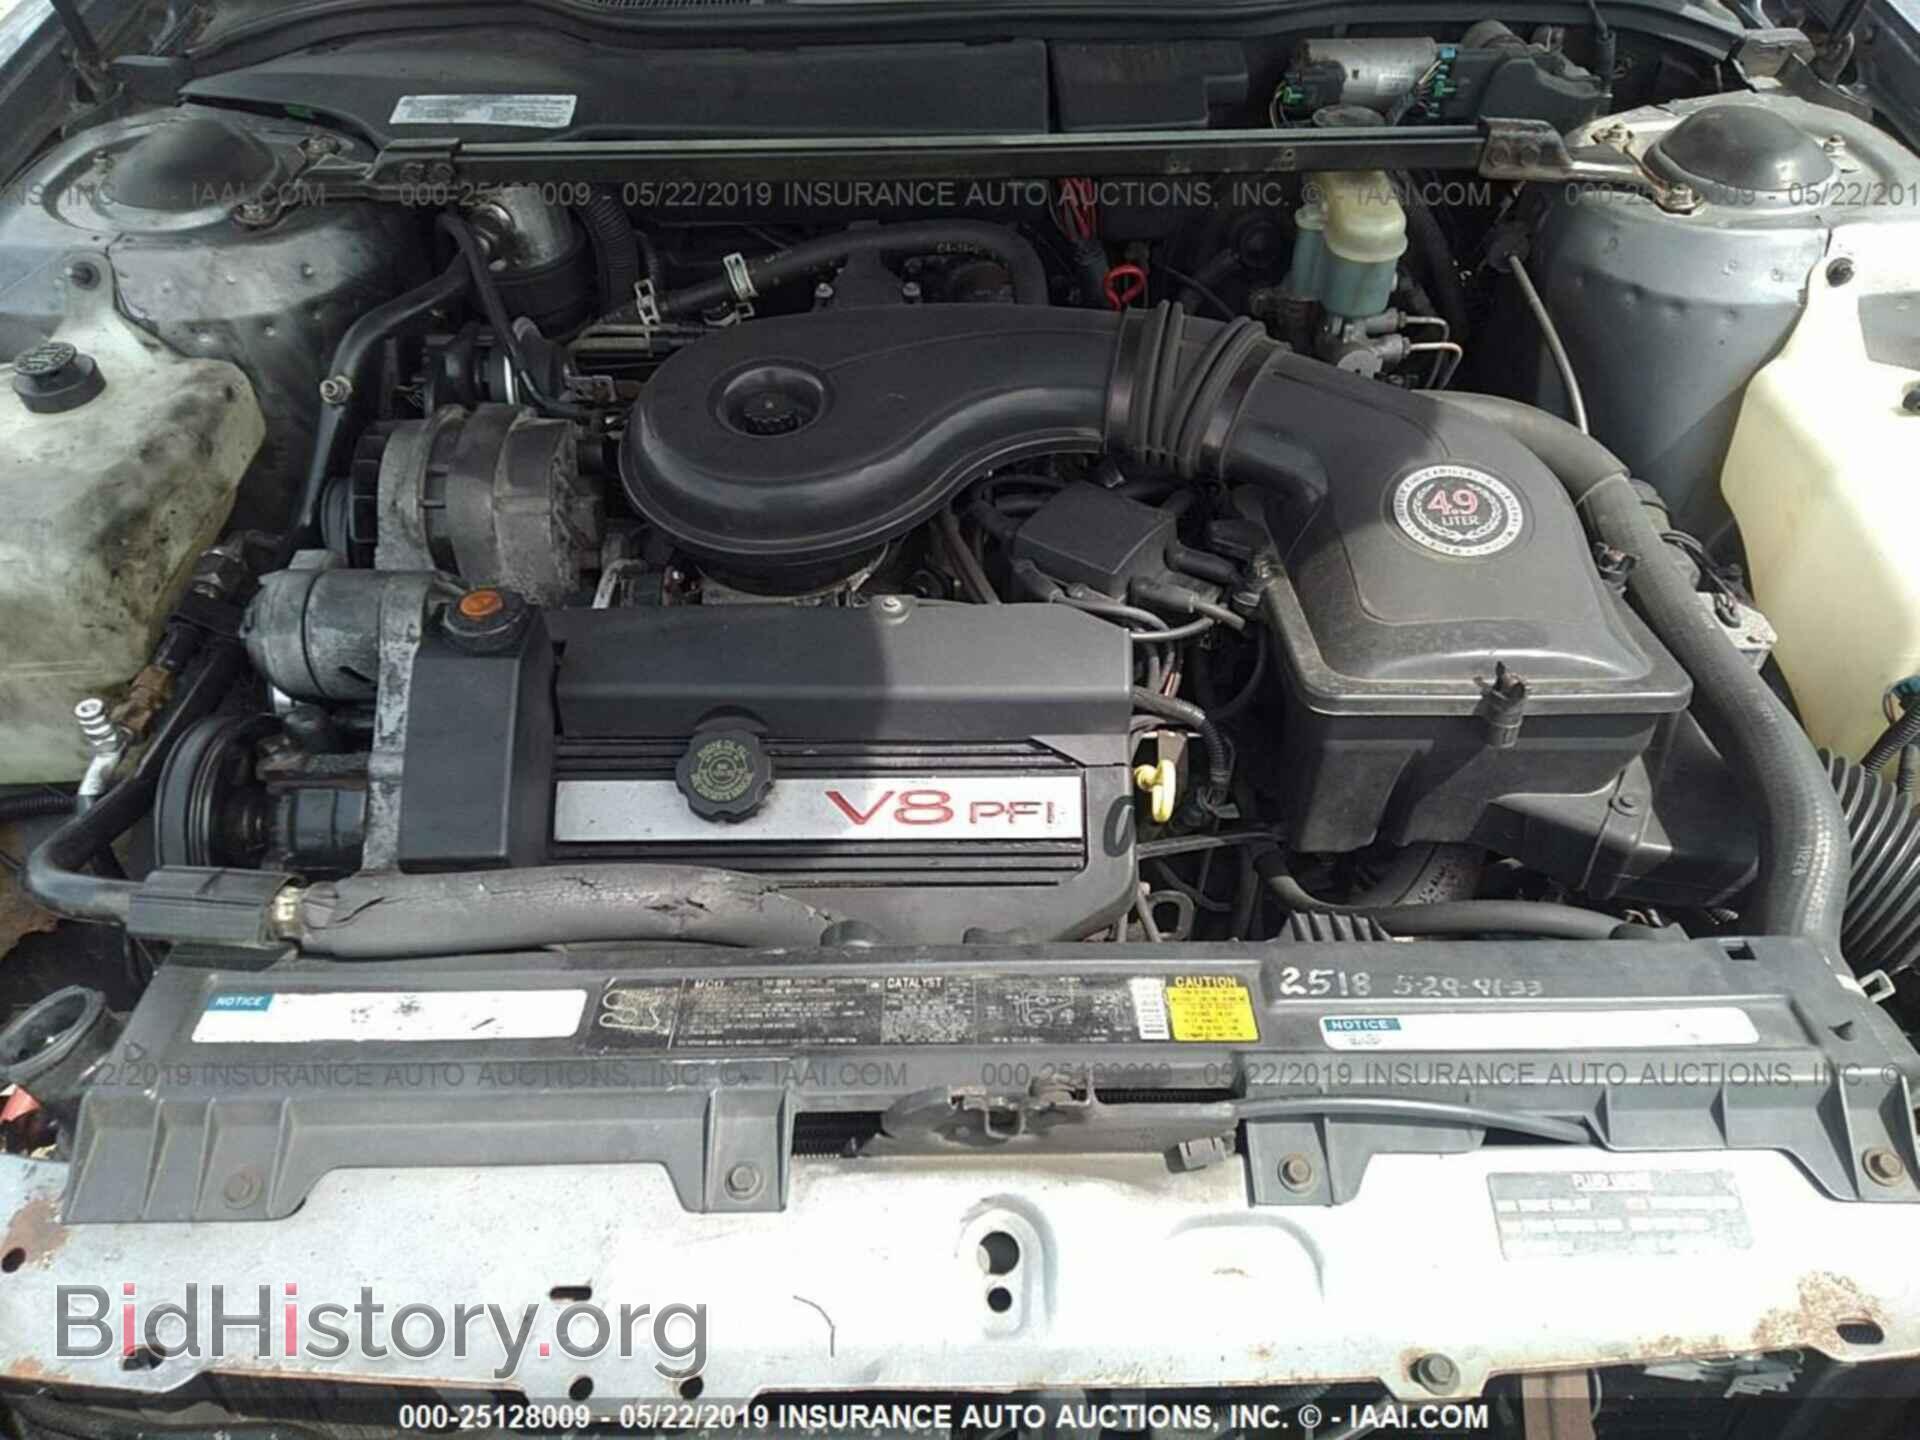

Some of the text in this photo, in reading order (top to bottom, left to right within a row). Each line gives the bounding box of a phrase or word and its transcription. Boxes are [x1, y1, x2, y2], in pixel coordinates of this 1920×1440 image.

[1427, 489, 1478, 515] 4.9
[1441, 515, 1480, 526] LITER
[825, 789, 1055, 826] V8 PFI
[887, 977, 943, 990] CATALYST
[1175, 976, 1237, 988] CAUTION
[1279, 966, 1372, 996] 2518
[215, 996, 264, 1006] NOTICE
[1330, 1019, 1390, 1031] NOTICE
